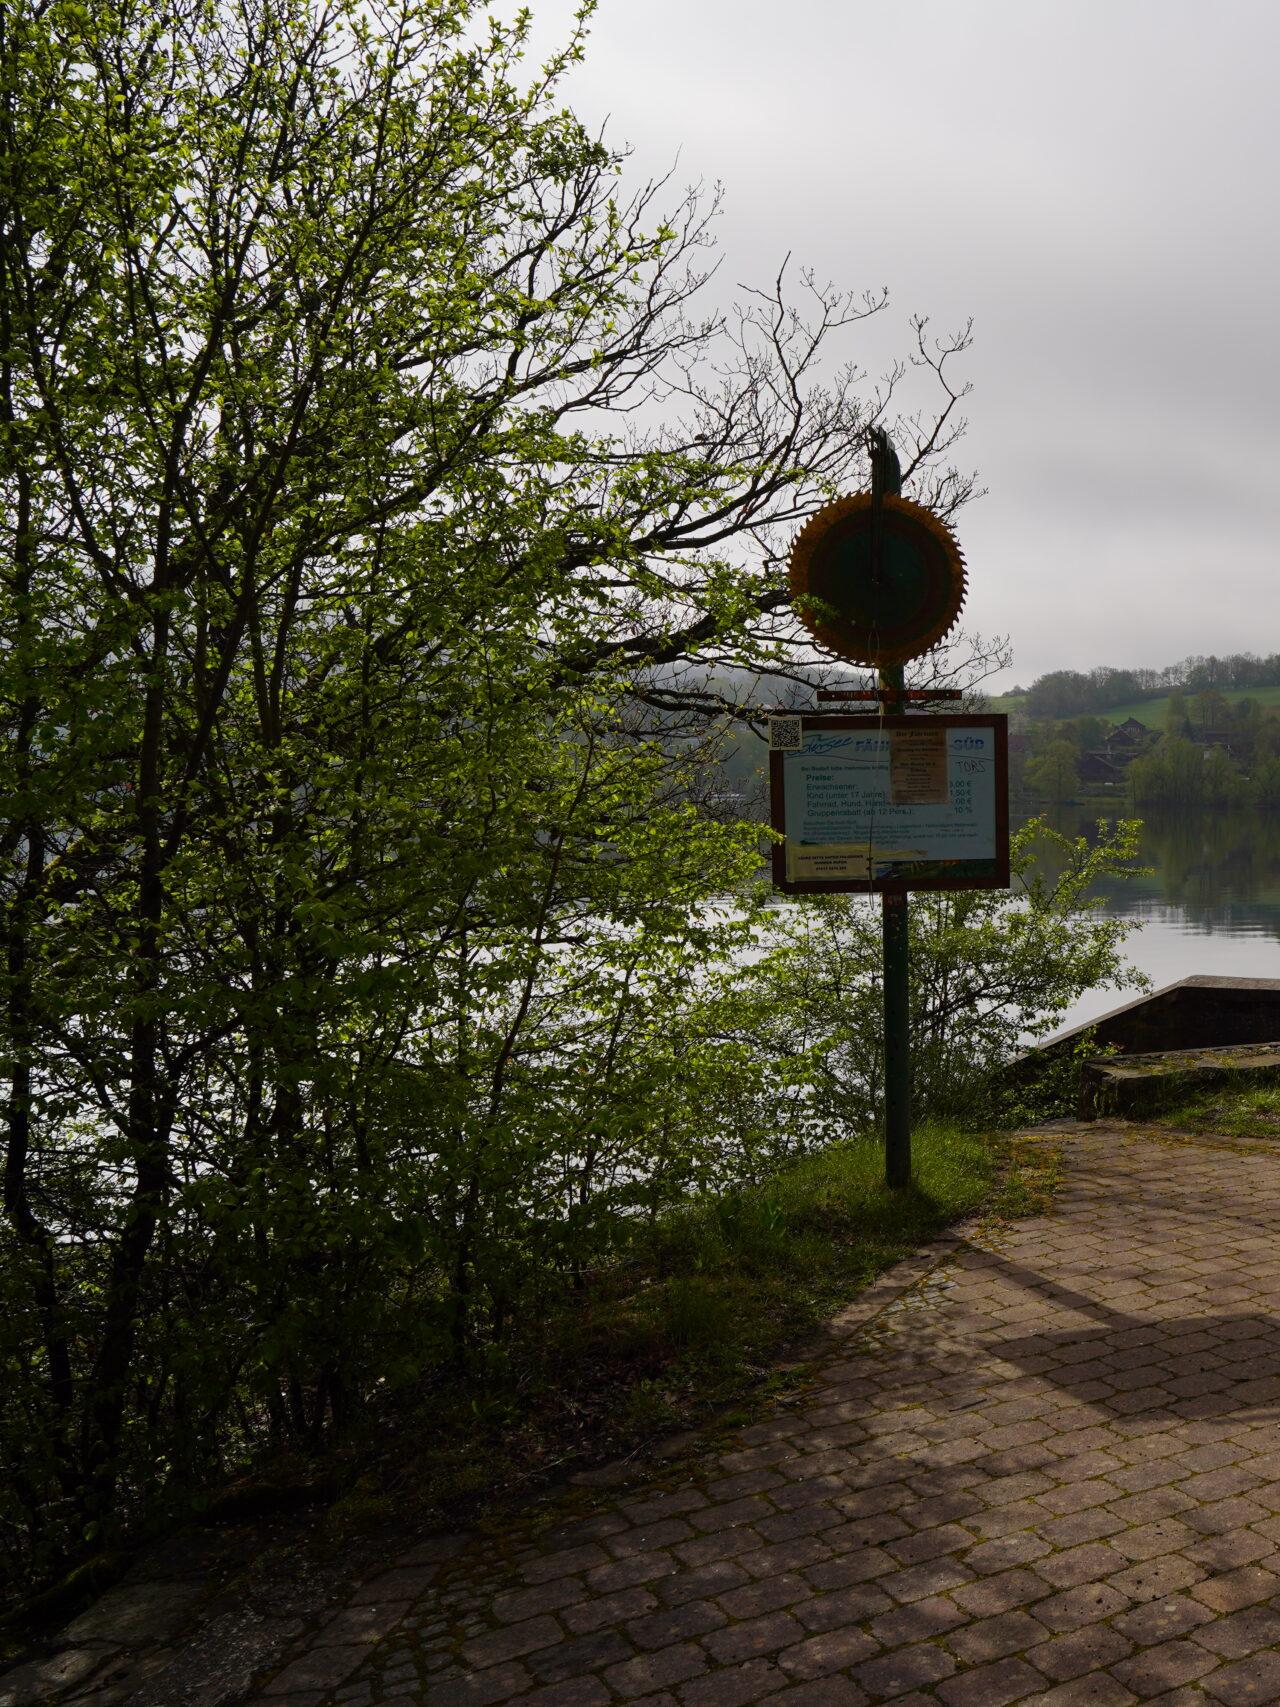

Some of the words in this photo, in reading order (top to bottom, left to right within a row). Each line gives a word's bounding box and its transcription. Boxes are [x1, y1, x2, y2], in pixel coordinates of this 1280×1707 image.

[807, 791, 823, 799] Kind
[826, 791, 847, 800] (unter
[954, 806, 963, 814] 10
